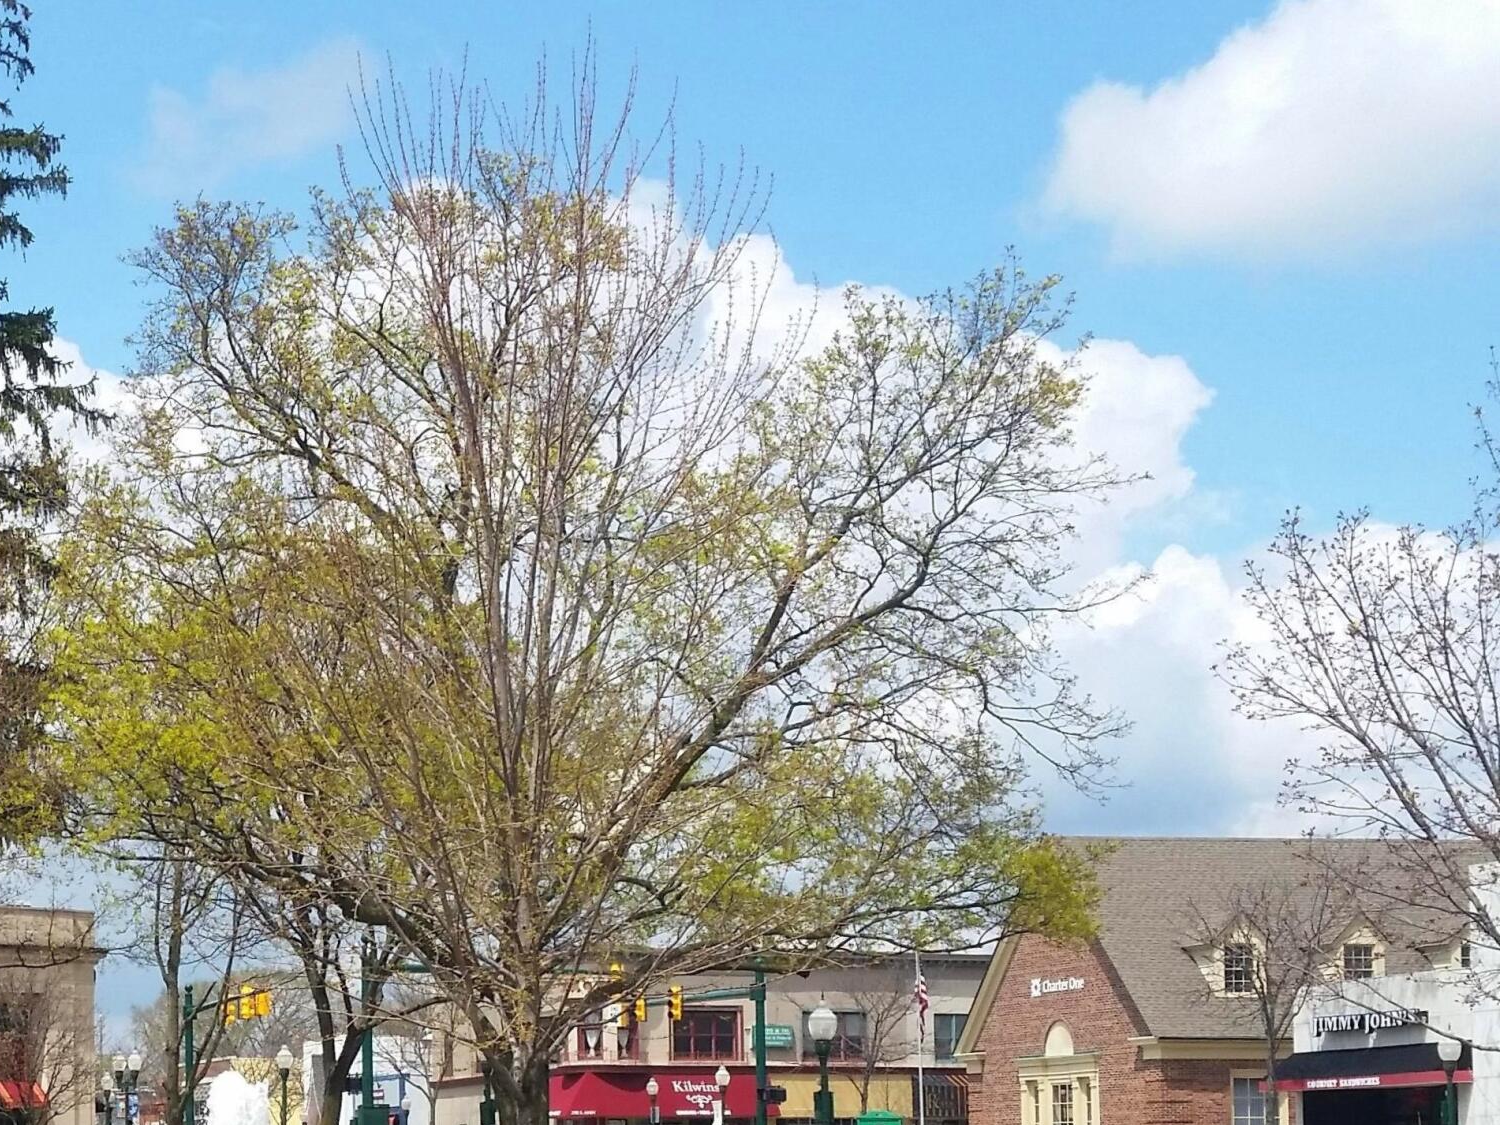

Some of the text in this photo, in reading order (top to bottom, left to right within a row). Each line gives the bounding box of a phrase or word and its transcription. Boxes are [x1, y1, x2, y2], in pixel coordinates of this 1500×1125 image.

[1042, 977, 1085, 993] Charter One
[1311, 1008, 1420, 1037] JIMMY JOHN'S
[672, 1080, 720, 1093] Kilwins
[1307, 1076, 1380, 1089] GOURMET SANDWICHES
